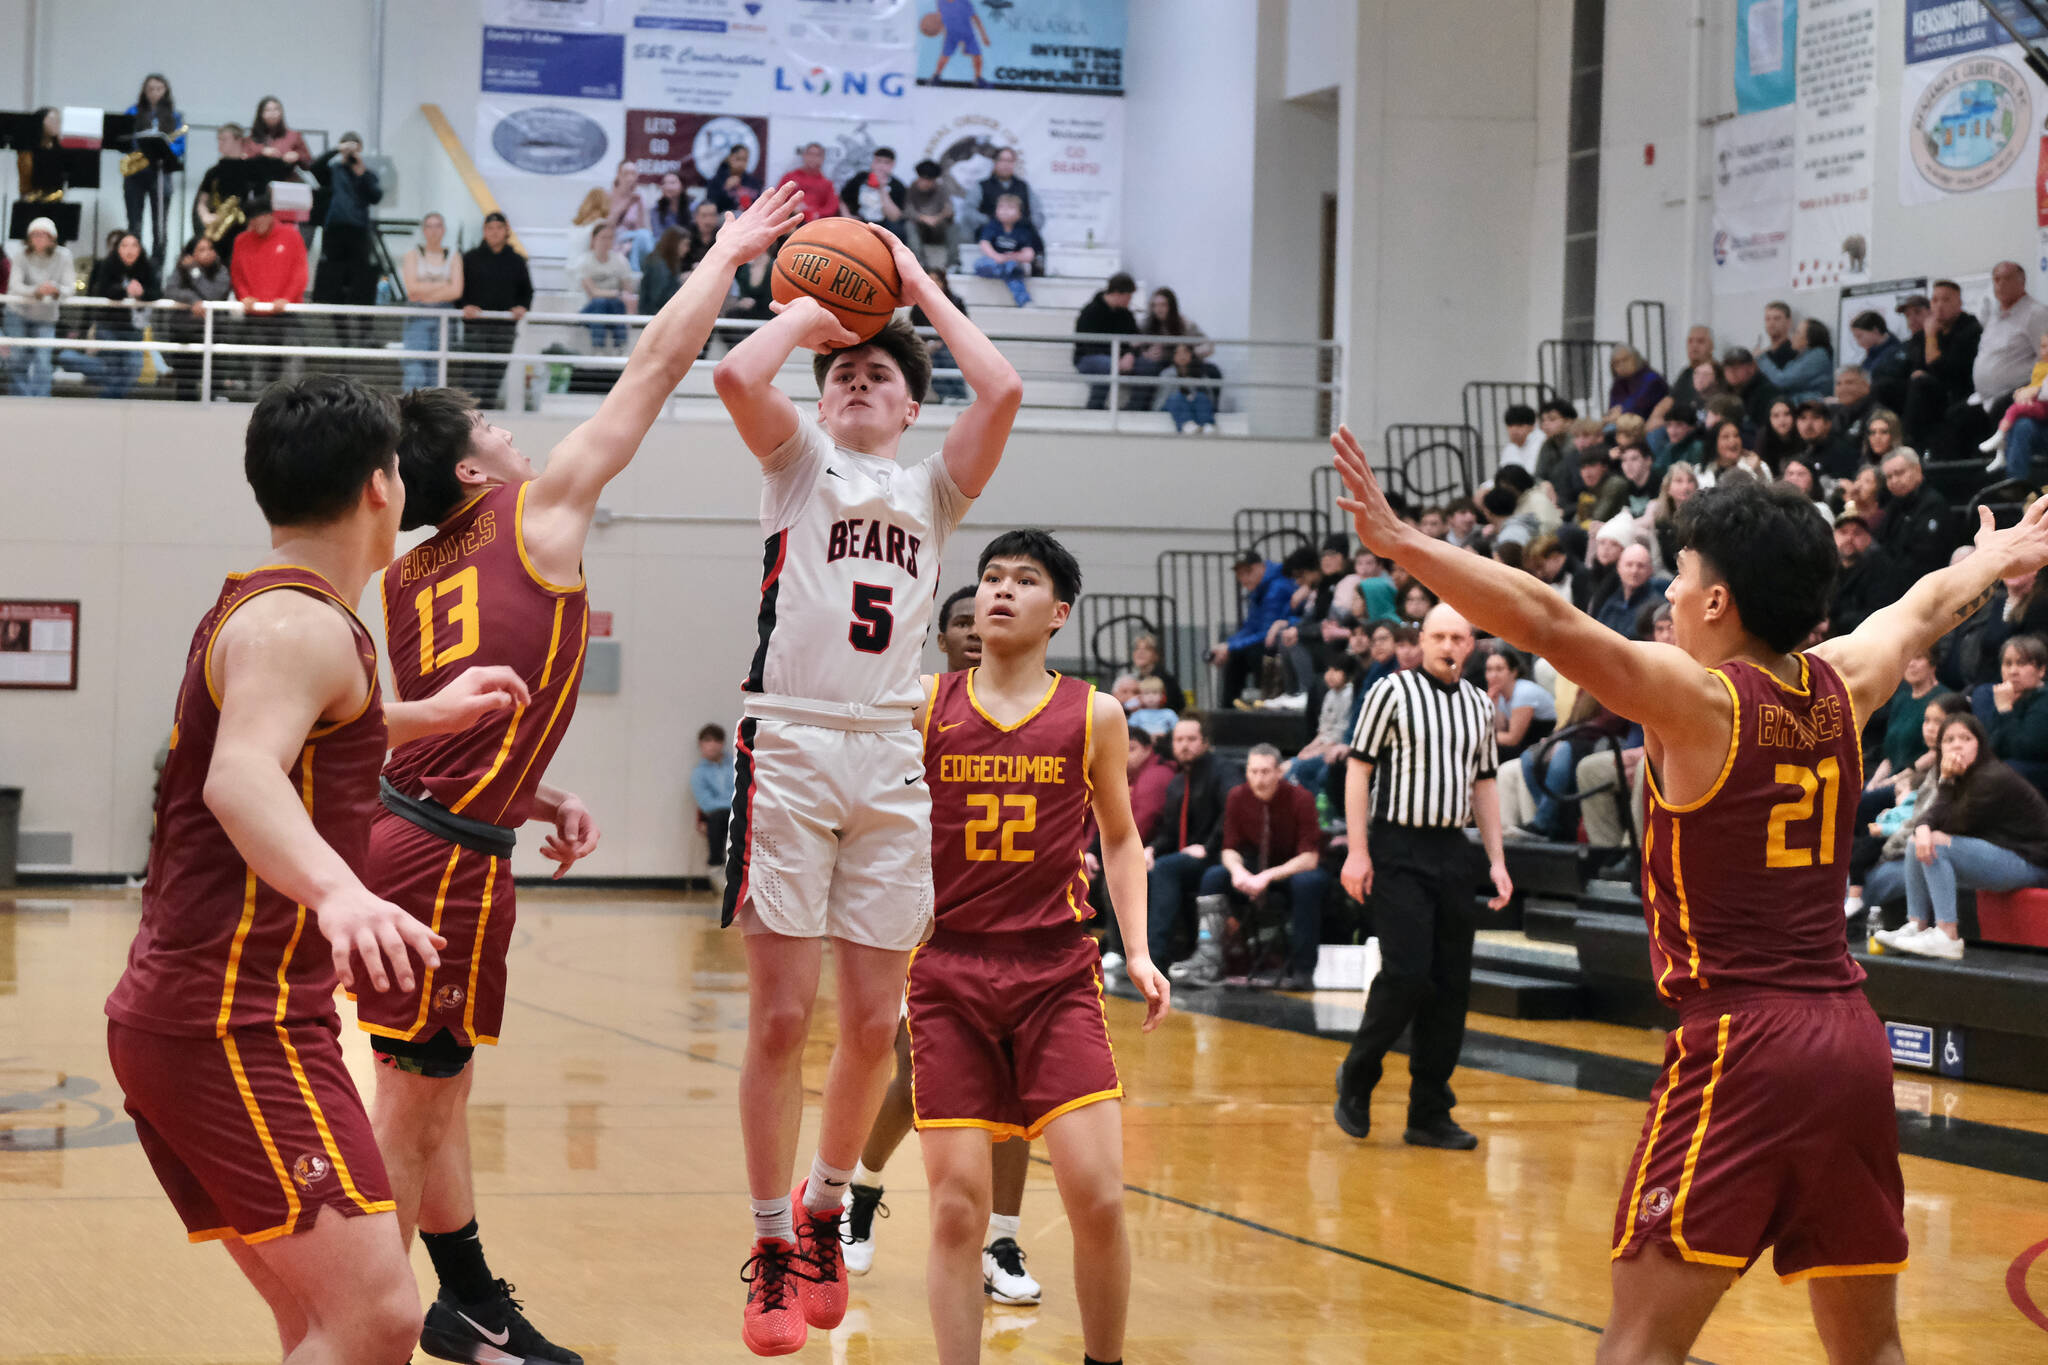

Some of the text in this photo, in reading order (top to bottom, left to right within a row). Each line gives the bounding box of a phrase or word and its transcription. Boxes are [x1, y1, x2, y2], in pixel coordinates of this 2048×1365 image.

[774, 66, 905, 97] LONG
[791, 252, 879, 307] THE ROCK
[827, 518, 921, 580] BEARS
[415, 565, 480, 677] 13
[848, 581, 894, 655] 5
[940, 754, 1067, 785] EDGECUMBE
[965, 793, 1038, 863] 22
[1766, 755, 1840, 868] 21
